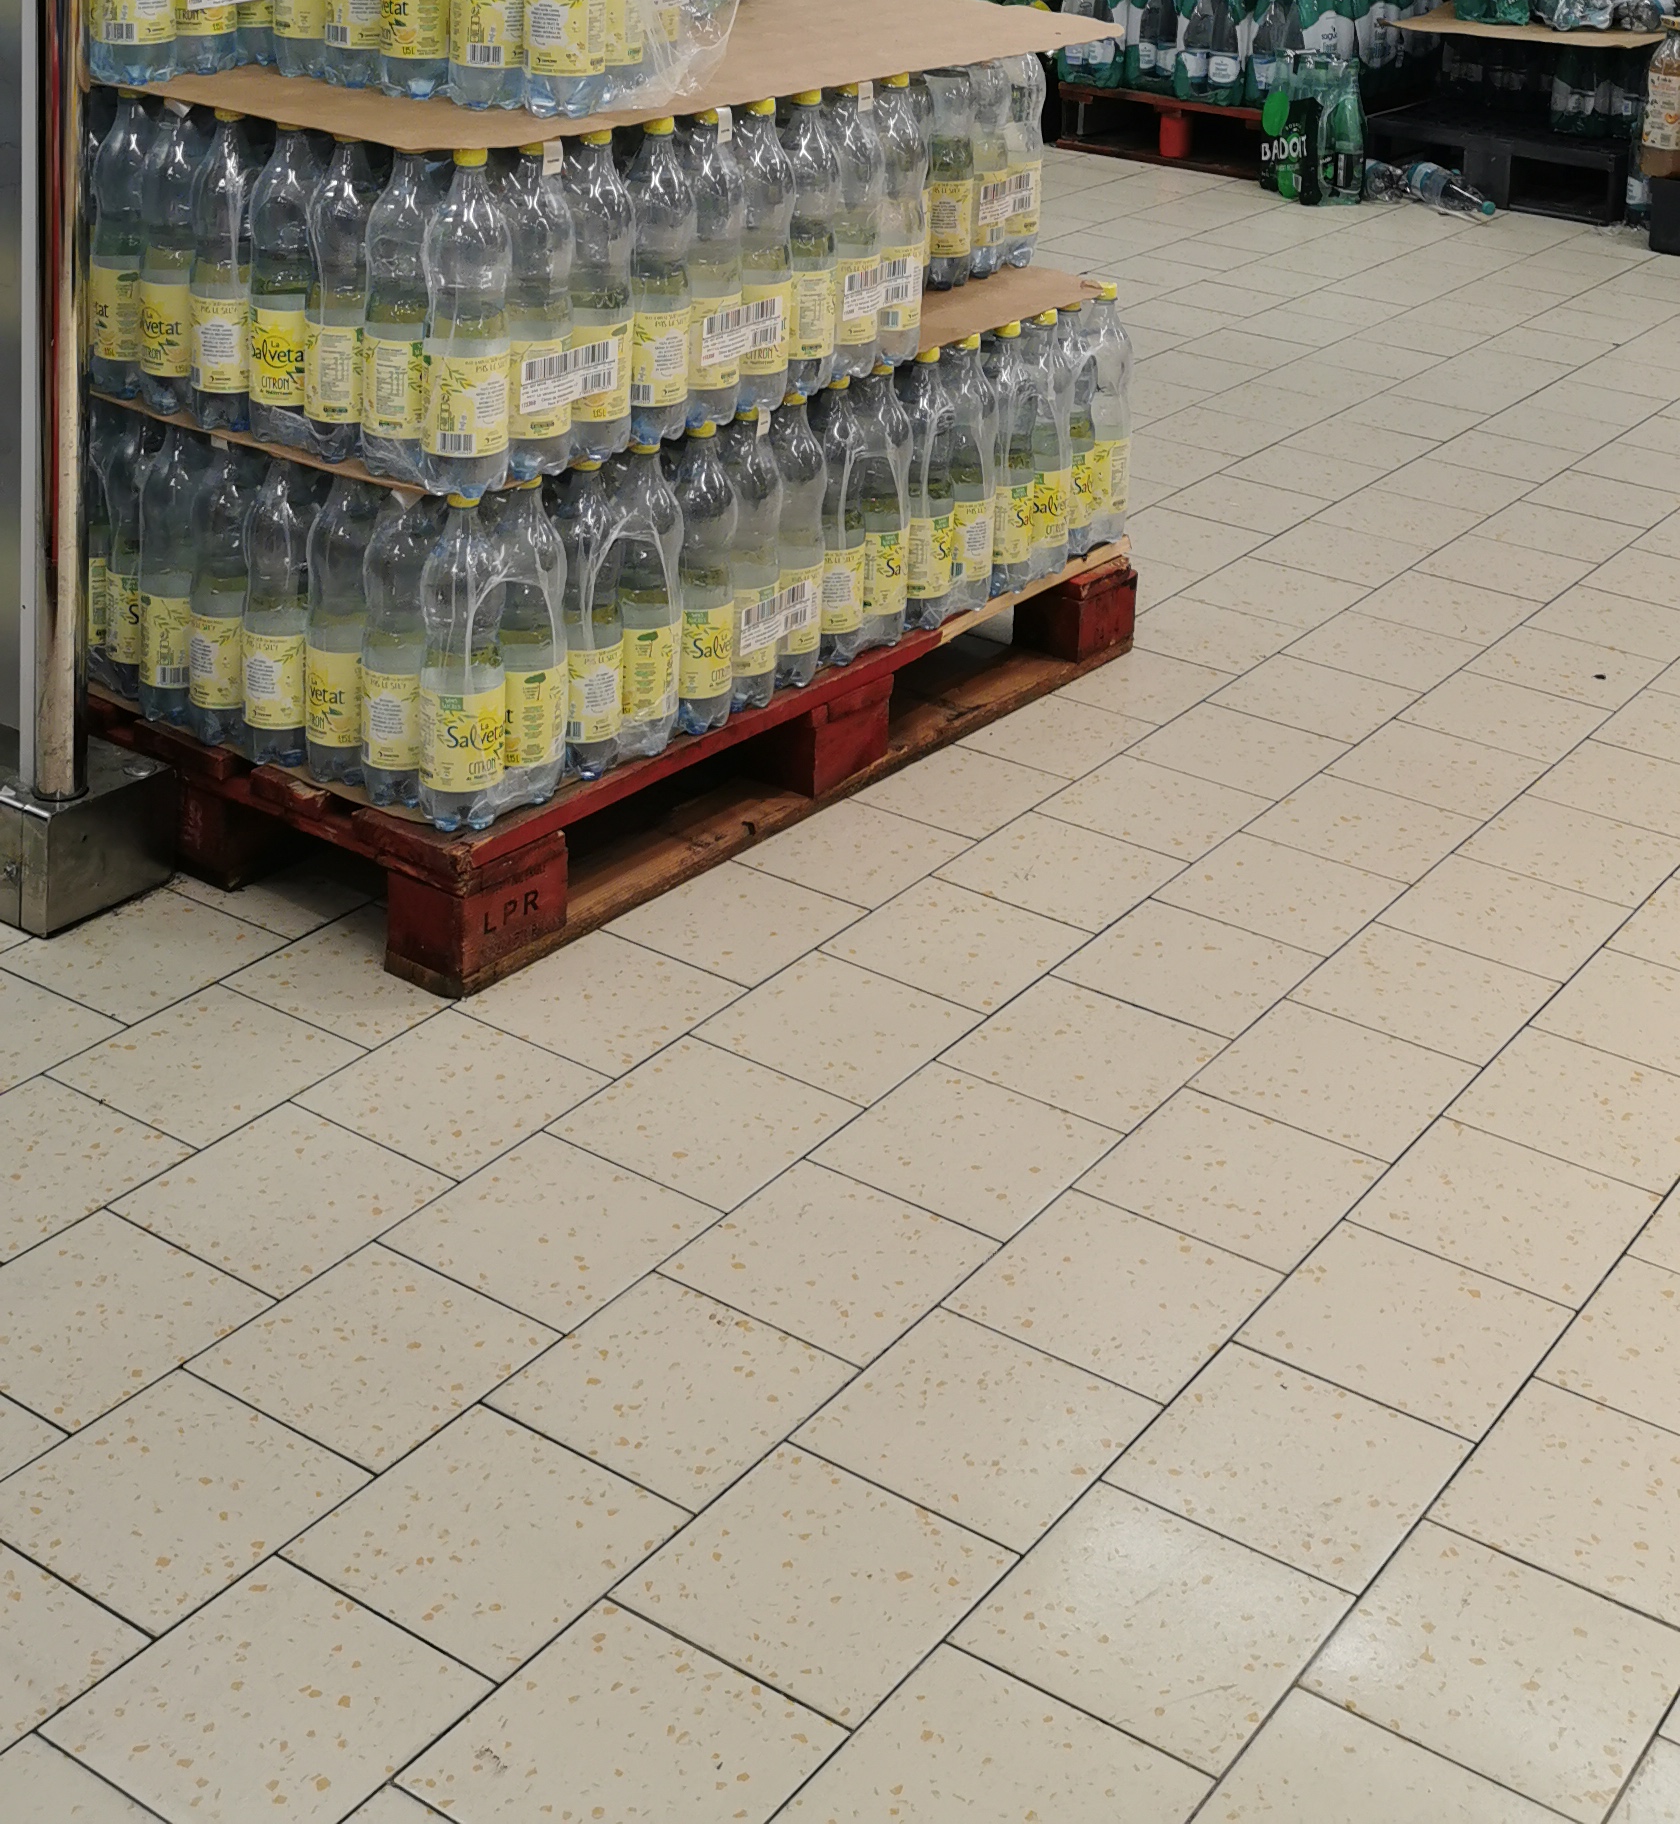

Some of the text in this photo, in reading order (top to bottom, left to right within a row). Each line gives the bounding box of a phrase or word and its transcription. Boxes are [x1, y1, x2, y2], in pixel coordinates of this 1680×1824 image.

[1261, 135, 1307, 161] BADOIT
[270, 340, 279, 348] La
[261, 376, 290, 390] CITRON
[309, 688, 346, 705] vetat
[480, 722, 489, 731] La
[446, 723, 504, 751] Salveta
[484, 889, 539, 935] LPR
